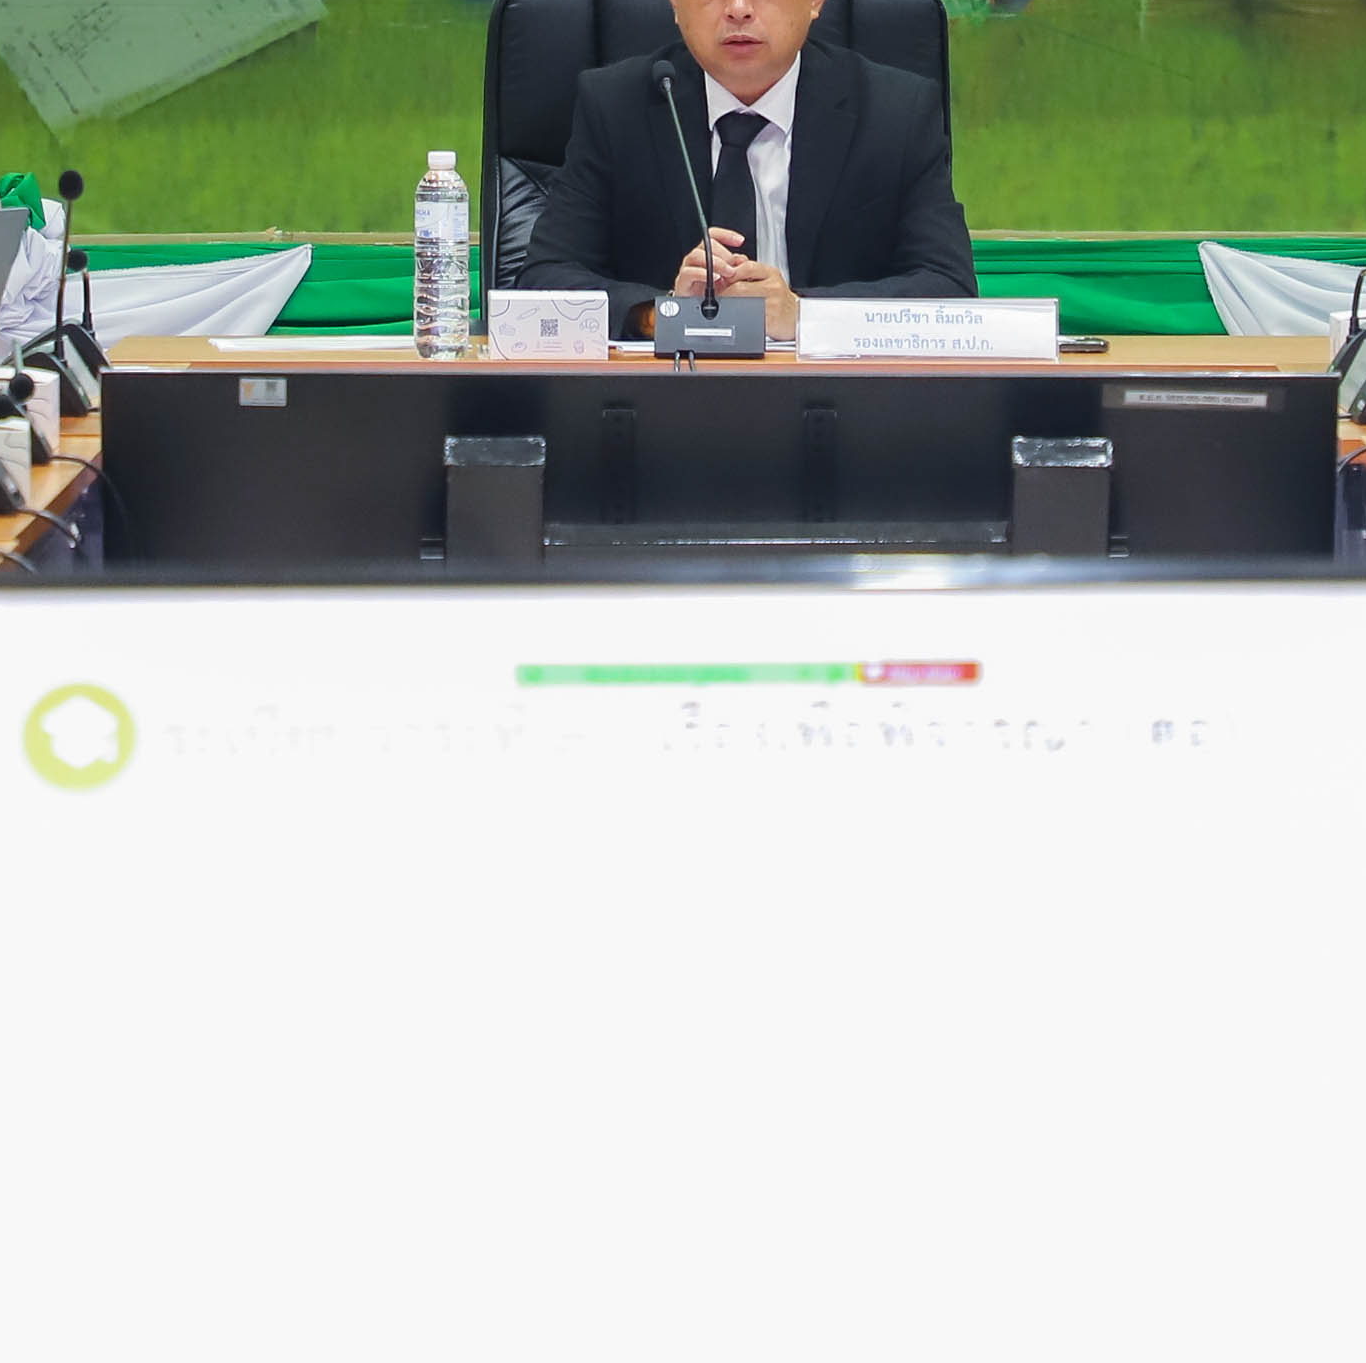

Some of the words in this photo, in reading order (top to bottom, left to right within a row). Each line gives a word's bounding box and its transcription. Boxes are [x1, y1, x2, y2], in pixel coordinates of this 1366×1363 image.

[864, 308, 930, 325] นายปรีชา
[934, 304, 984, 325] ลิ้มถวิล
[853, 334, 947, 350] รองเลขาธิการ
[952, 335, 994, 351] ส.ป.ก.
